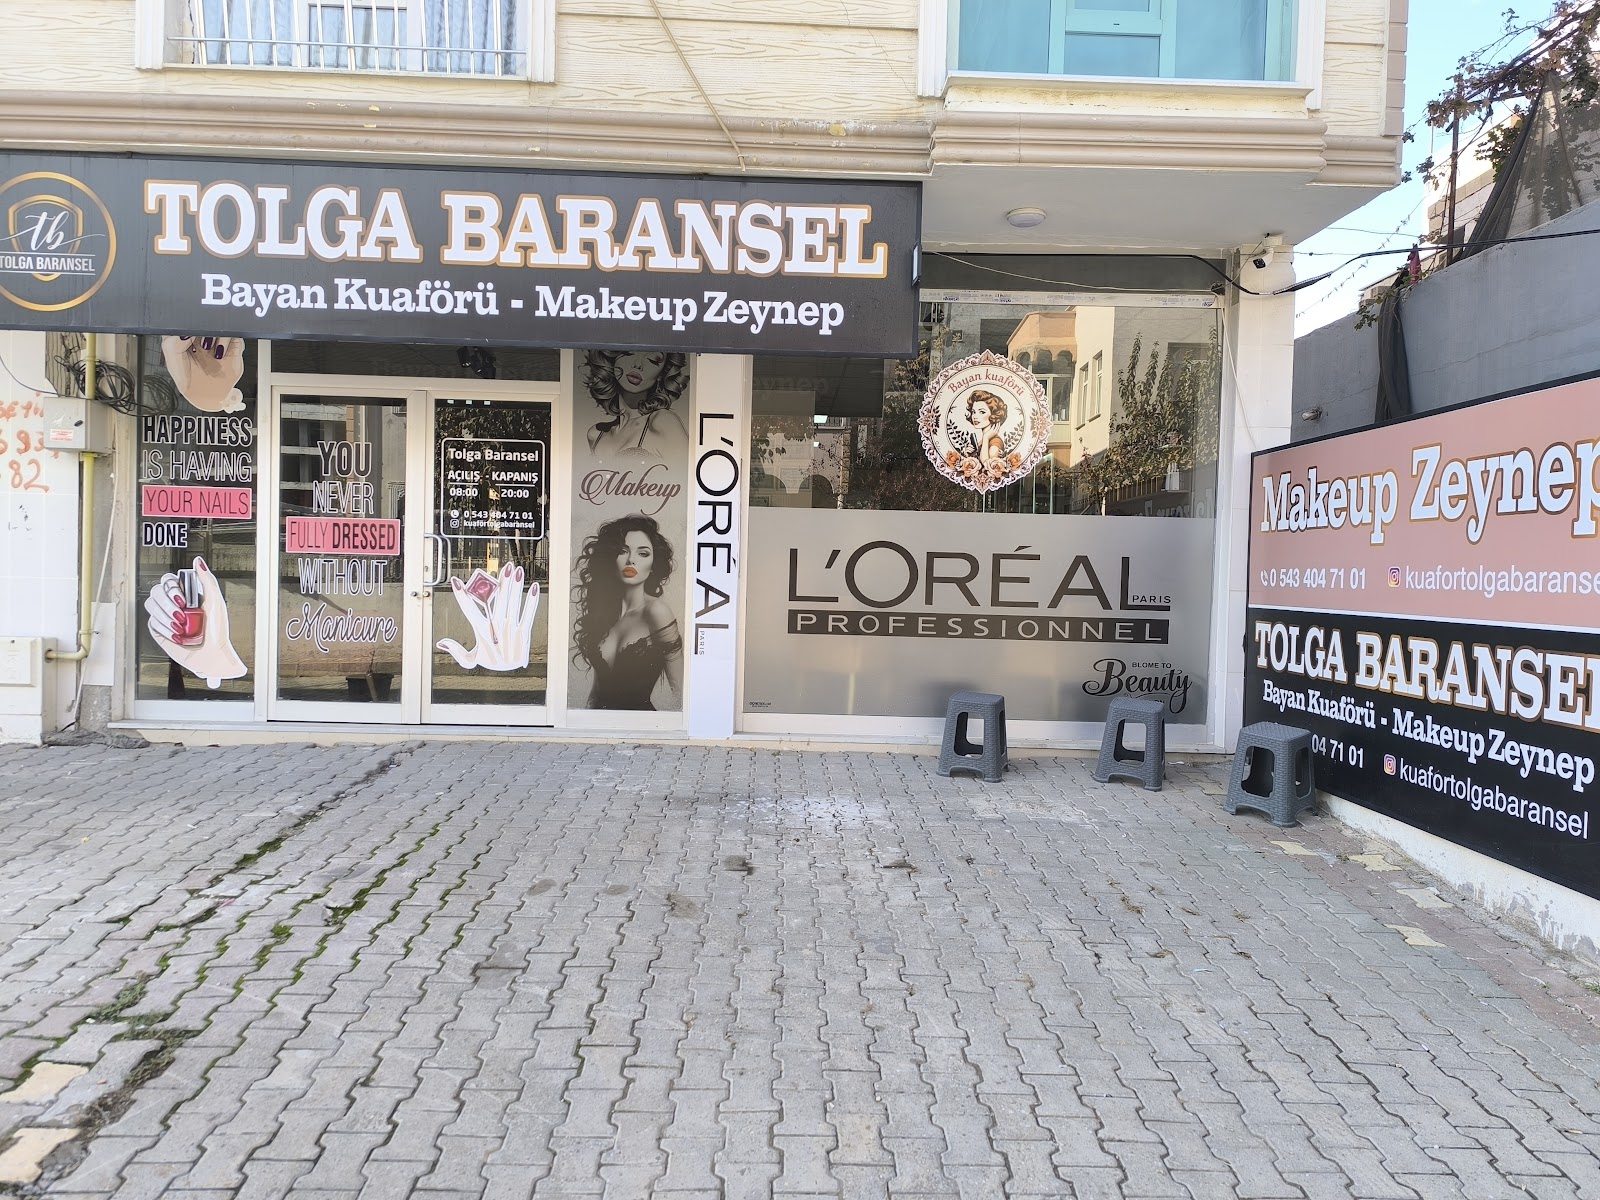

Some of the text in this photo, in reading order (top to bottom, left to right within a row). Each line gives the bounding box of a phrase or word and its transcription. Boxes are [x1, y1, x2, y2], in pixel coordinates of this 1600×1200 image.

[145, 180, 888, 278] TOLGA BARANSEL
[0, 255, 95, 272] TOLGA BARANSEL
[201, 273, 327, 317] Bayan
[334, 278, 499, 316] Kuaförü
[535, 285, 698, 331] Makeup
[703, 290, 844, 335] Zeynep
[947, 368, 1025, 397] Bayan kuaförü
[142, 415, 252, 447] HAPPINESS
[143, 449, 252, 482] IS HAVING
[317, 440, 372, 477] YOU
[448, 448, 539, 462] Tolga Baransel
[448, 470, 480, 482] AÇILIŞ
[492, 471, 539, 484] KAPANIŞ
[449, 488, 529, 498] 08:00 20:00
[579, 463, 681, 516] Makeup
[145, 489, 249, 515] YOUR NAILS
[312, 480, 374, 515] NEVER
[1260, 466, 1398, 545] Makeup
[472, 511, 488, 519] 543
[509, 511, 520, 520] 71
[522, 512, 533, 520] 01
[143, 522, 188, 548] DONE
[290, 521, 396, 551] FULLY DRESSED
[298, 557, 388, 596] WITHOUT
[1269, 567, 1366, 590] 0 543 404 71 01
[1132, 594, 1171, 604] PARIS
[286, 602, 397, 653] Manicure
[795, 612, 1162, 641] PROFESSIONNEL
[1255, 620, 1348, 684] TOLGA
[1082, 658, 1192, 714] Beauty
[1262, 679, 1306, 713] Bayan
[1307, 688, 1376, 729] Kuaförü
[1392, 708, 1484, 764] Makeup
[1488, 728, 1595, 792] Zeynep
[1311, 733, 1364, 769] 04 71 01
[1399, 757, 1589, 839] kuafortolgabaransel
